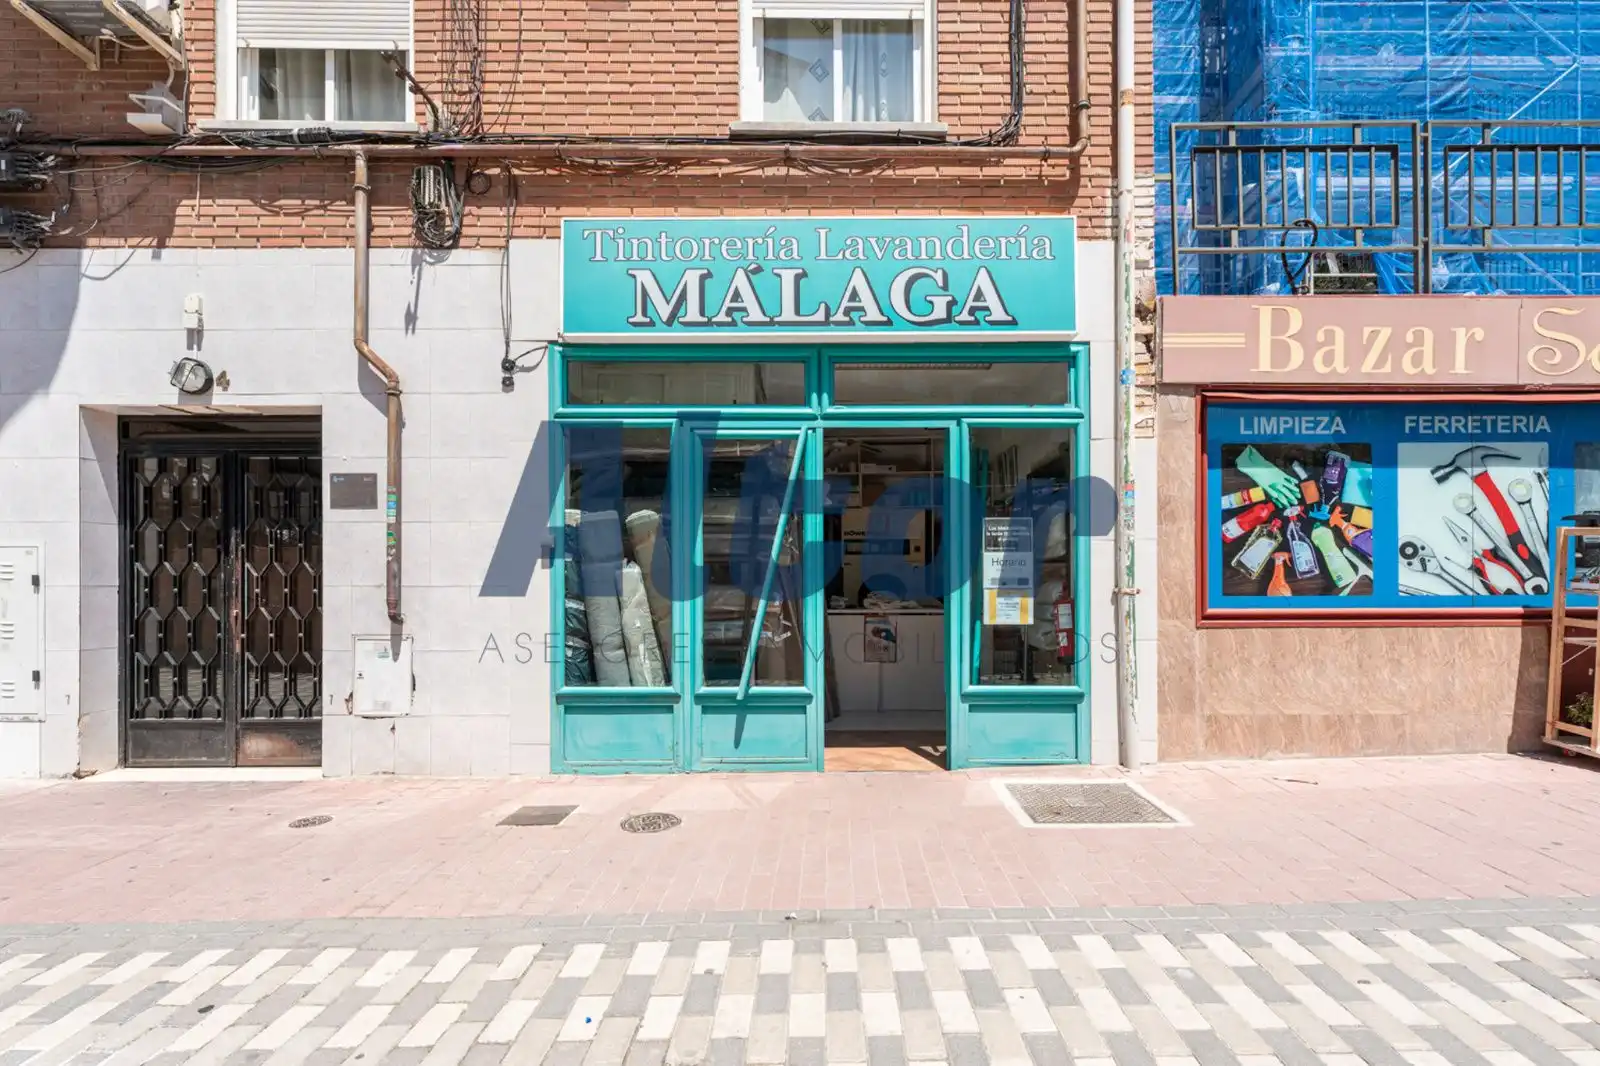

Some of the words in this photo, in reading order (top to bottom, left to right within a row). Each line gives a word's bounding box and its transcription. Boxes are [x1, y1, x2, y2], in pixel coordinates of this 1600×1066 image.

[582, 225, 802, 262] Tintorería
[814, 225, 1055, 262] Lavandería
[626, 263, 1018, 328] MÁLAGA
[1250, 304, 1485, 375] Bazar
[1239, 416, 1346, 435] LIMPIEZA
[1404, 415, 1551, 434] FERRETERIA
